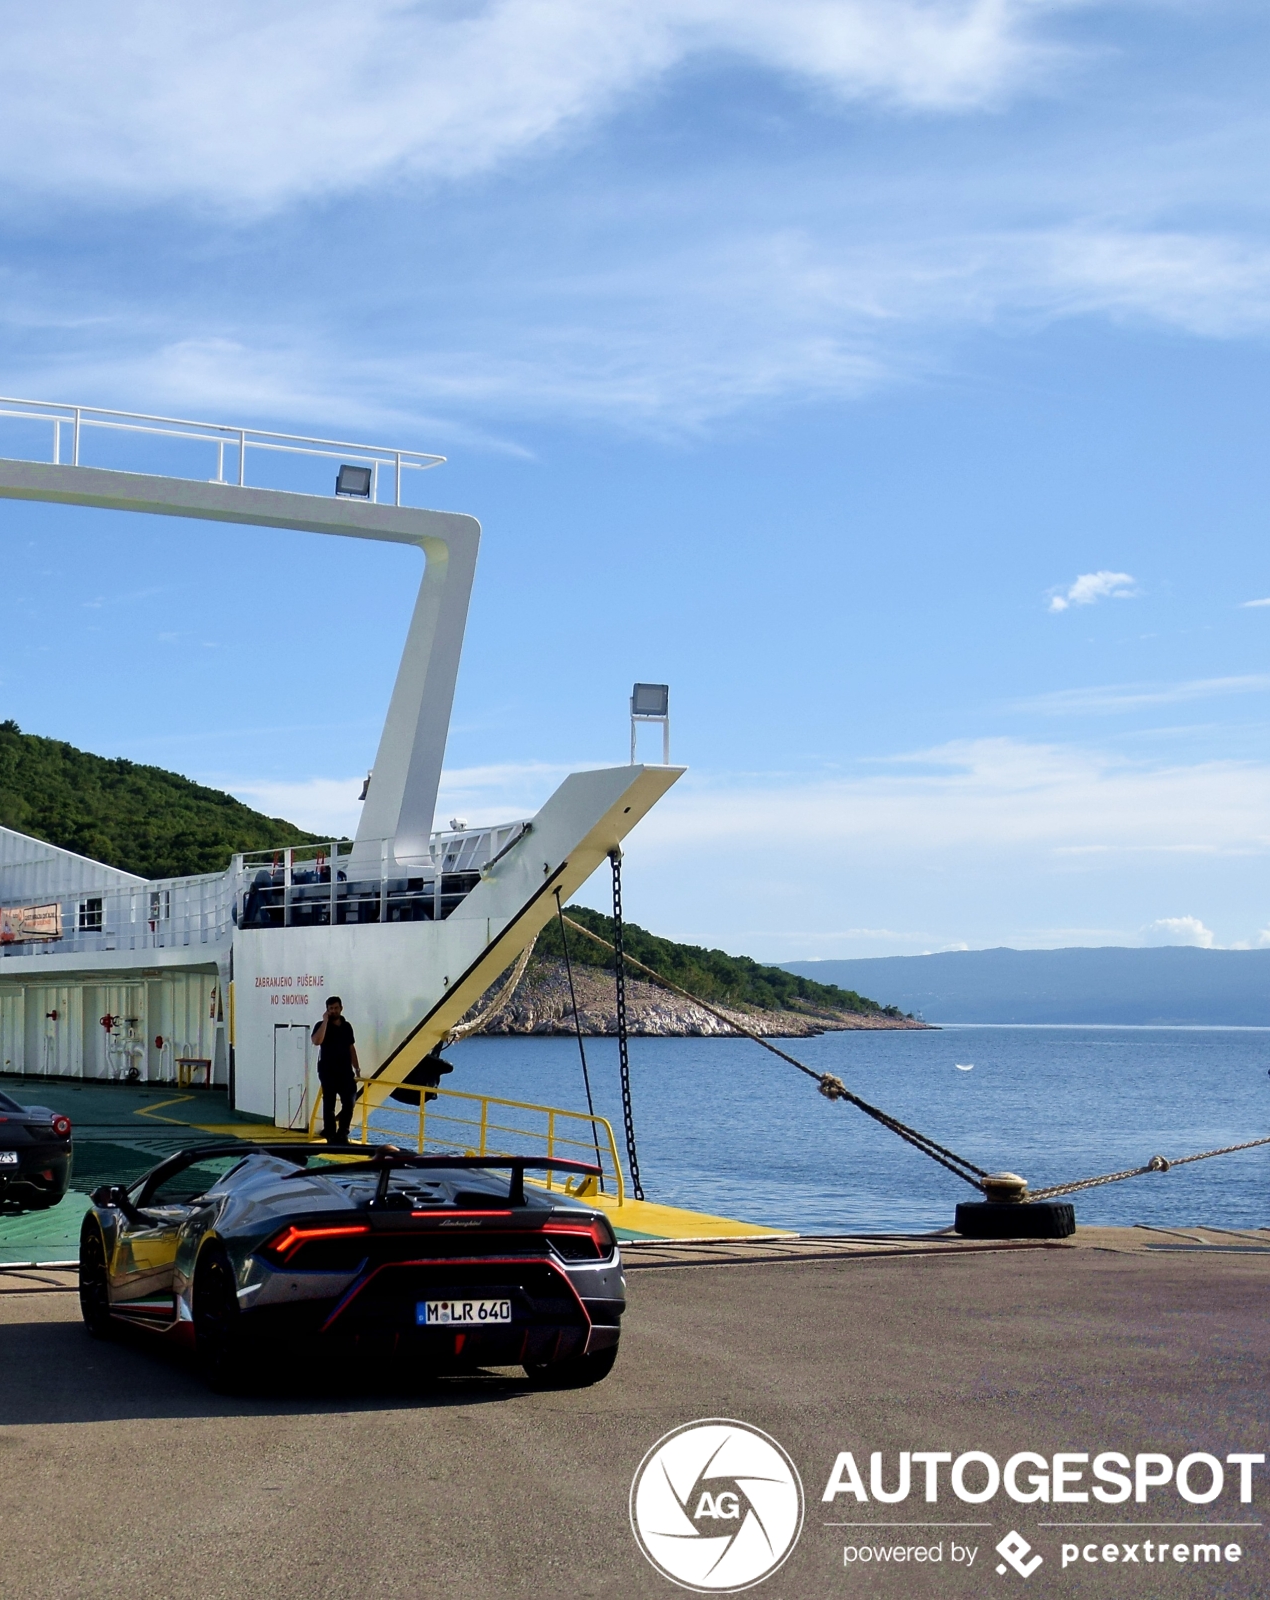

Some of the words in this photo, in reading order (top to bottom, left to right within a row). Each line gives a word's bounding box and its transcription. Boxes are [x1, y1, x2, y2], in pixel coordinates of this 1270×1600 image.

[255, 976, 292, 988] ZABRANJENO
[297, 974, 324, 987] PUŠENJE
[271, 995, 279, 1005] NO
[282, 994, 308, 1005] SMOKING
[427, 1303, 439, 1322] M
[451, 1303, 474, 1321] LR
[477, 1301, 510, 1320] 640
